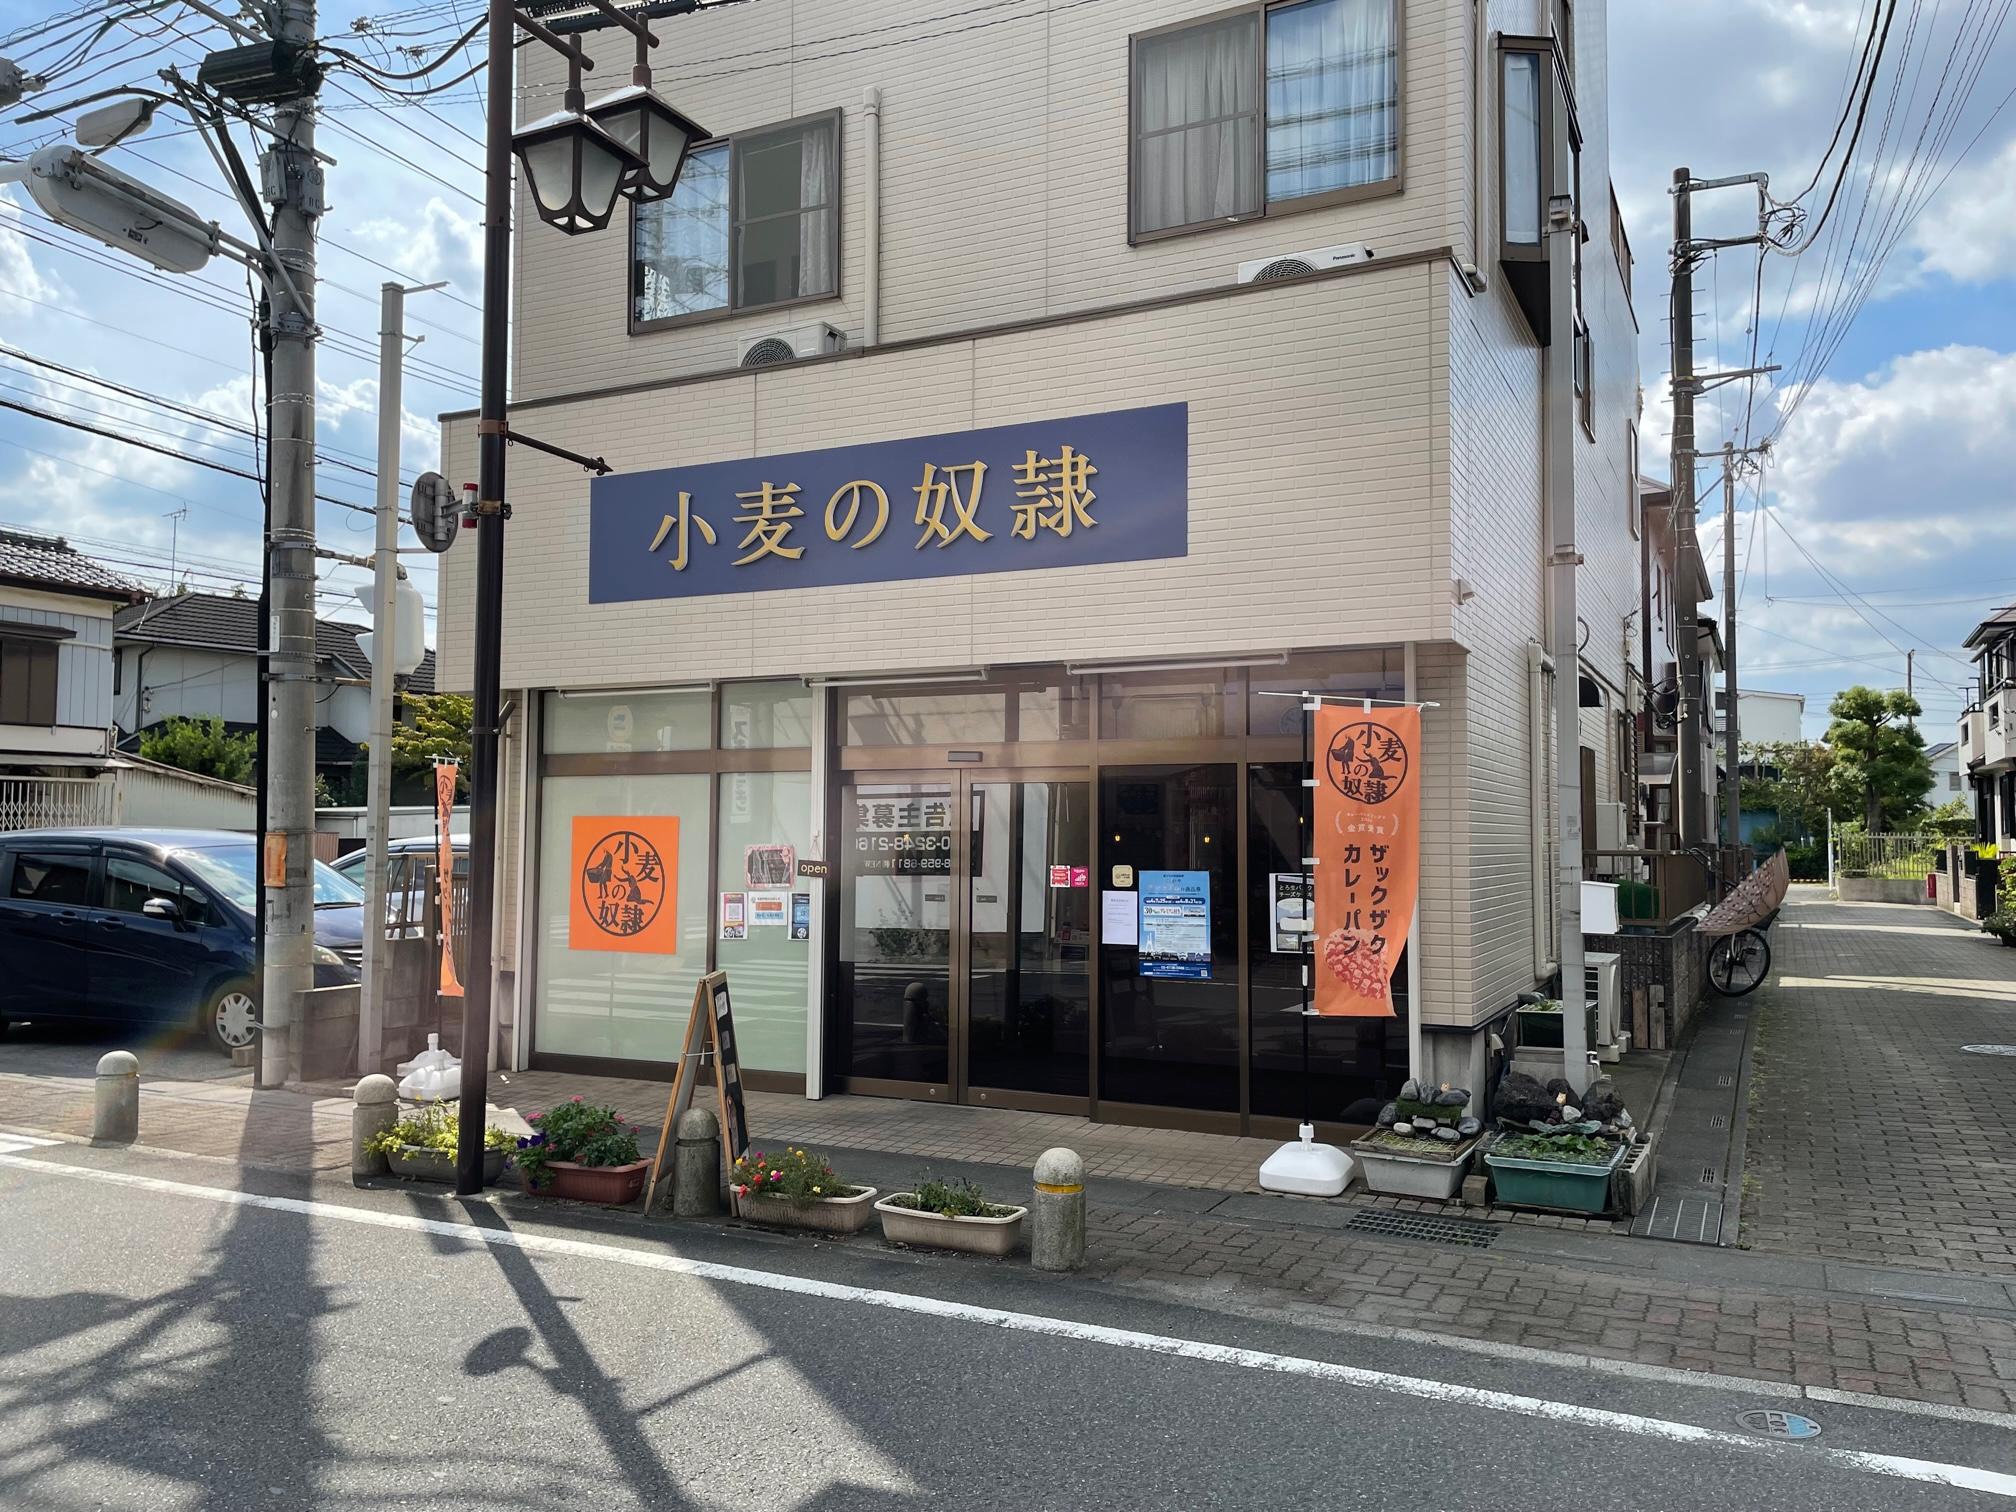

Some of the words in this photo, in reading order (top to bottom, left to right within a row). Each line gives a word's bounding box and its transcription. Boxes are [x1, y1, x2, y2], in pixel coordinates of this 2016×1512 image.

[1332, 253, 1356, 261] Panasonic
[648, 444, 1100, 573] 小麦の奴隷
[800, 864, 828, 875] open
[1343, 844, 1362, 956] カレーパン
[1369, 844, 1391, 955] ザックザク
